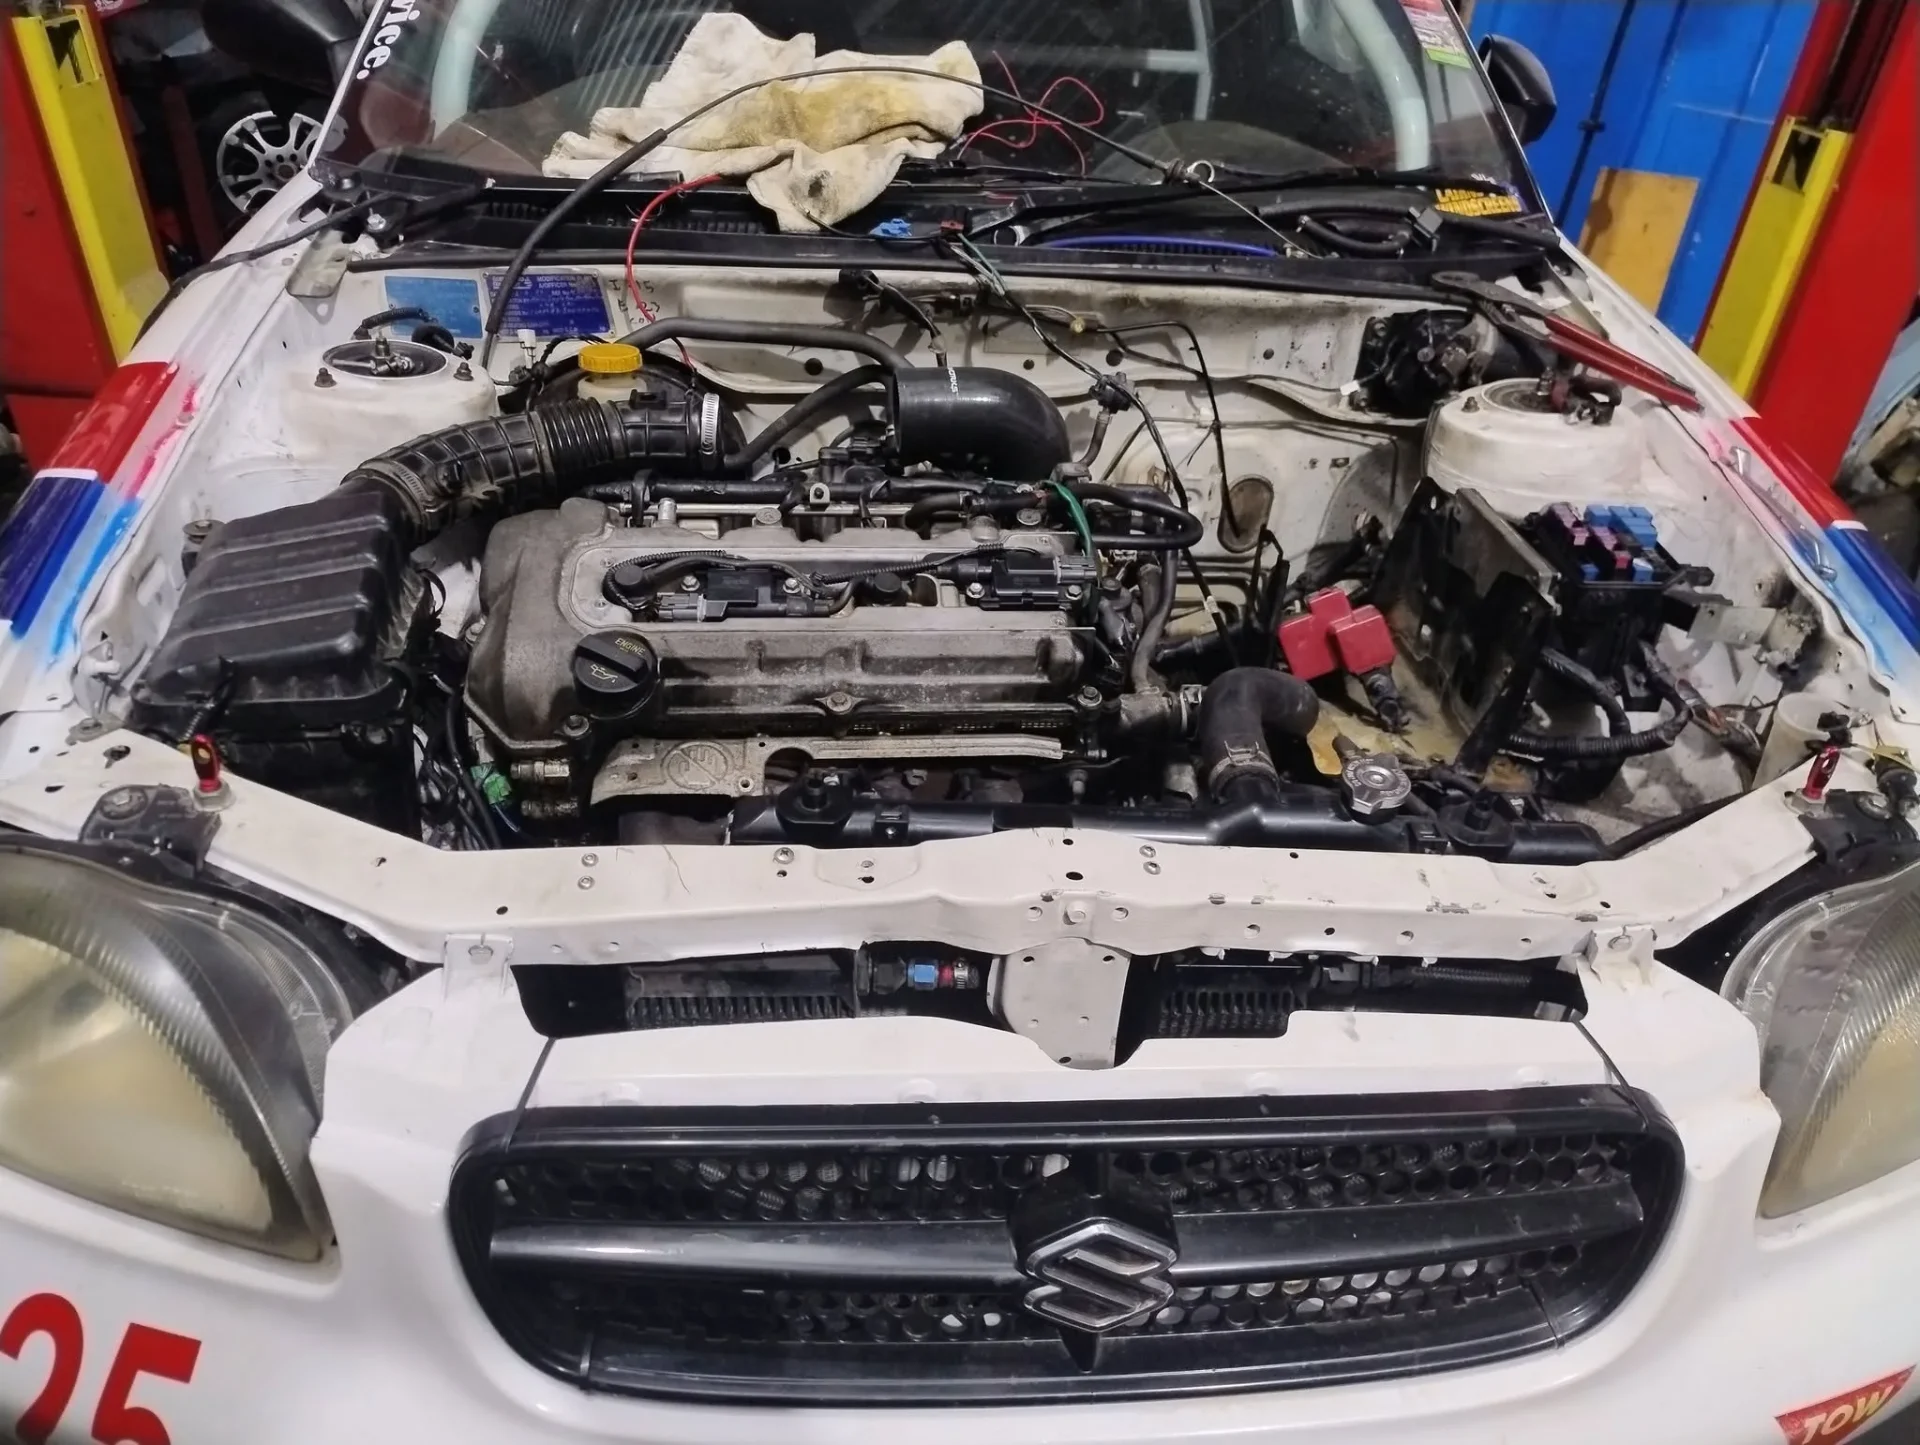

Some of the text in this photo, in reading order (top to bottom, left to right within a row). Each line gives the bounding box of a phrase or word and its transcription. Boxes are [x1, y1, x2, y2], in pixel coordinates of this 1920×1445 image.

[614, 637, 646, 655] ENGINE
[0, 1293, 202, 1445] 25
[1802, 1384, 1895, 1445] TOW
